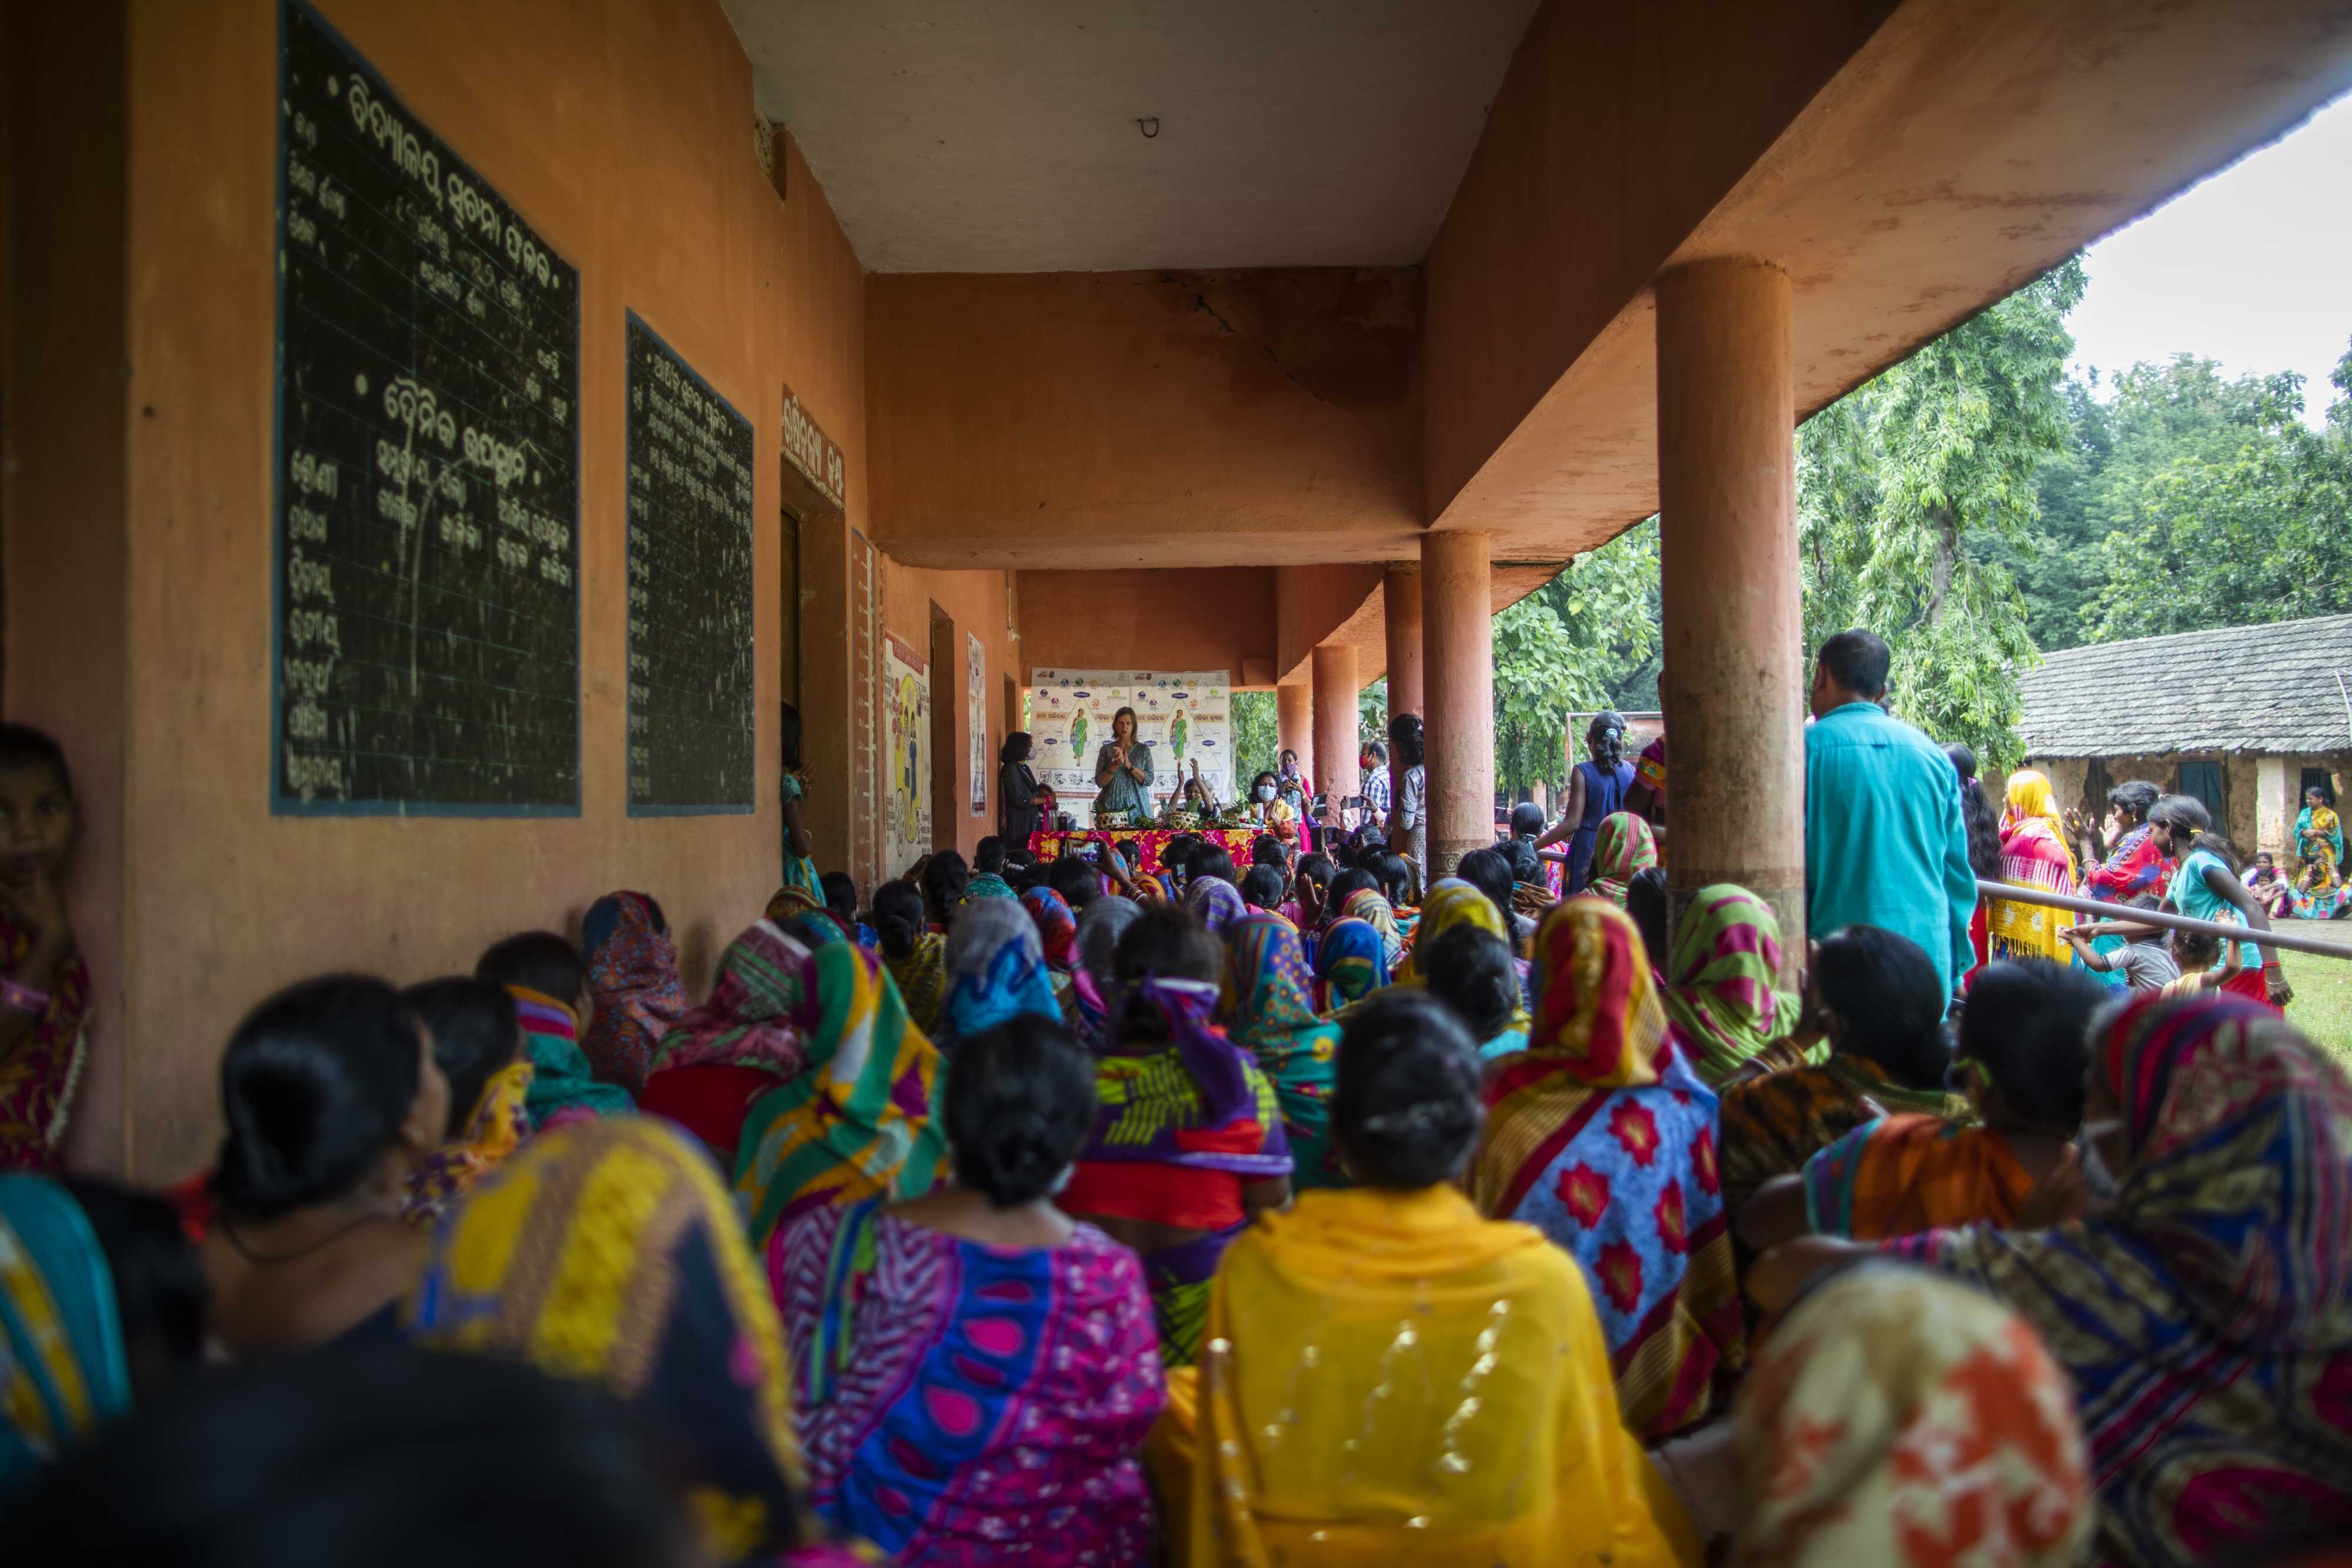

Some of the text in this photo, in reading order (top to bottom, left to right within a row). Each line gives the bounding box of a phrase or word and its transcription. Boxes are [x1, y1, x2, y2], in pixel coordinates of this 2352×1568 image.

[349, 75, 442, 210] ବିଦ୍ୟାଳୟ
[447, 173, 500, 243] ସୂଚନା
[506, 226, 549, 286] ଫଳକ
[385, 377, 525, 487] ଦୈନିକ ଉପସ୍ଥାନ
[827, 444, 841, 497] କକ୍ଷ
